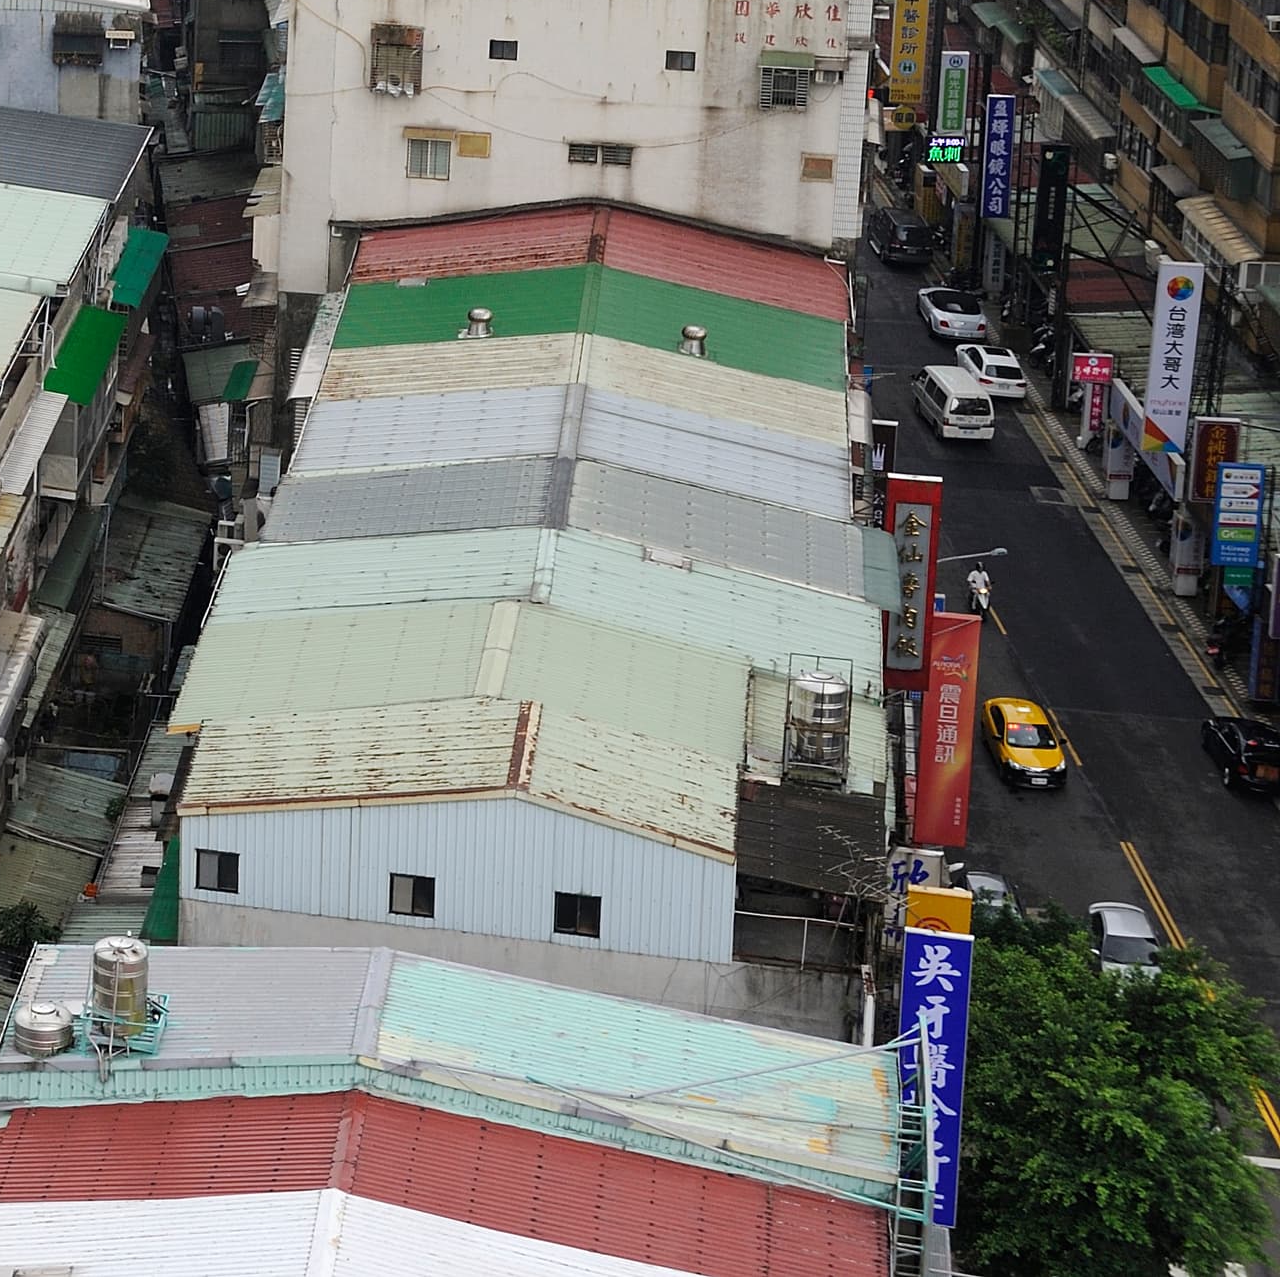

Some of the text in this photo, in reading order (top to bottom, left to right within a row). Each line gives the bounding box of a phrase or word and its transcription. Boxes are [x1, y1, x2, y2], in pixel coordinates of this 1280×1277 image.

[927, 146, 961, 162] 魚刺
[934, 683, 962, 764] 震旦通訊
